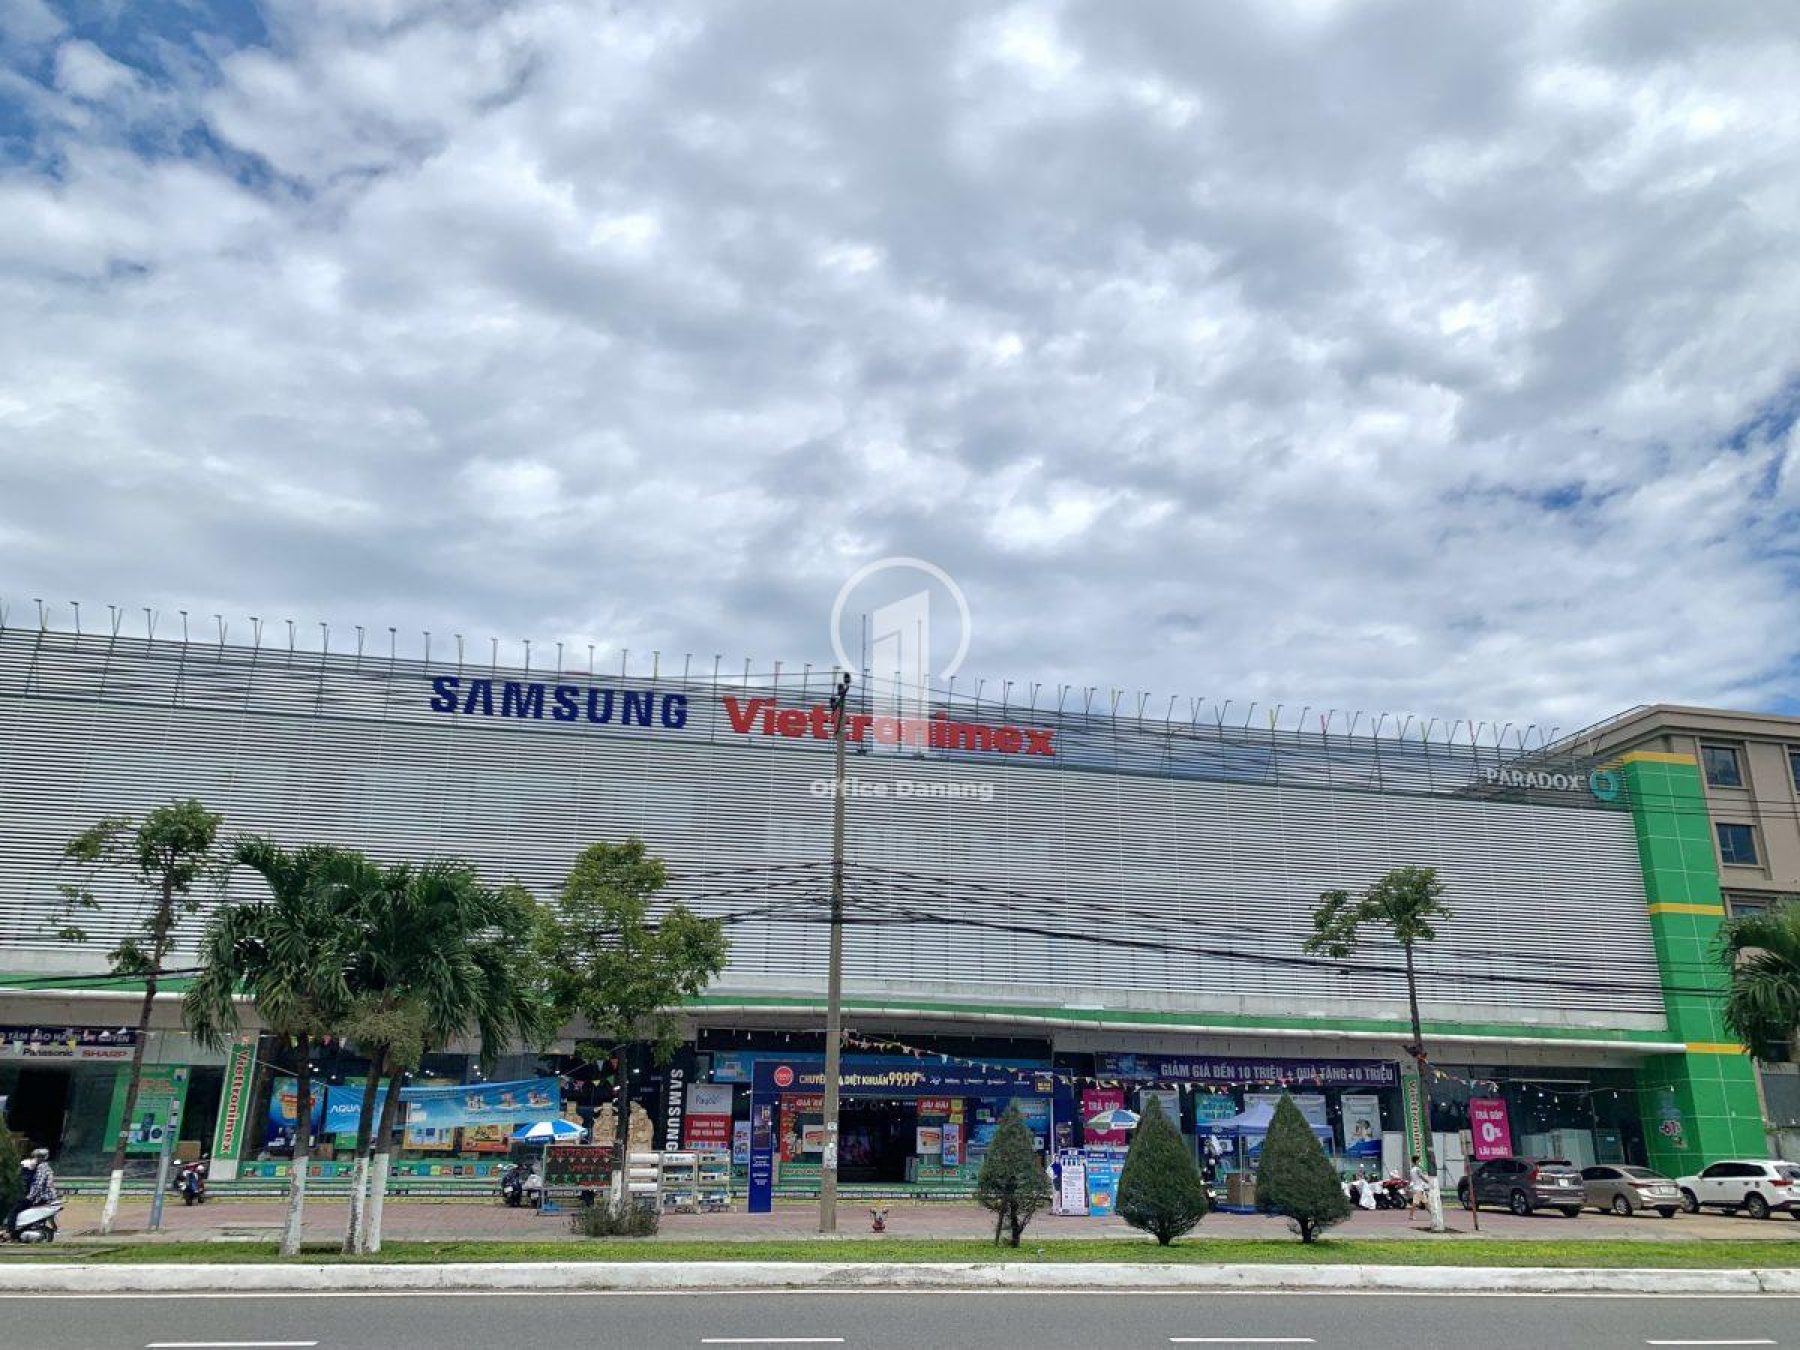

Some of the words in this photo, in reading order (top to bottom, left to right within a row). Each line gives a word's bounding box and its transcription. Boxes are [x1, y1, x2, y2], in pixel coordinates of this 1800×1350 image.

[430, 676, 688, 730] SAMSUNG
[1486, 767, 1580, 791] PARADOX
[81, 1049, 129, 1058] SHARP
[799, 1074, 826, 1084] CHUYÊ
[1238, 1066, 1251, 1079] 10
[329, 1104, 361, 1114] AQUA
[665, 1068, 684, 1151] SAMSUNG
